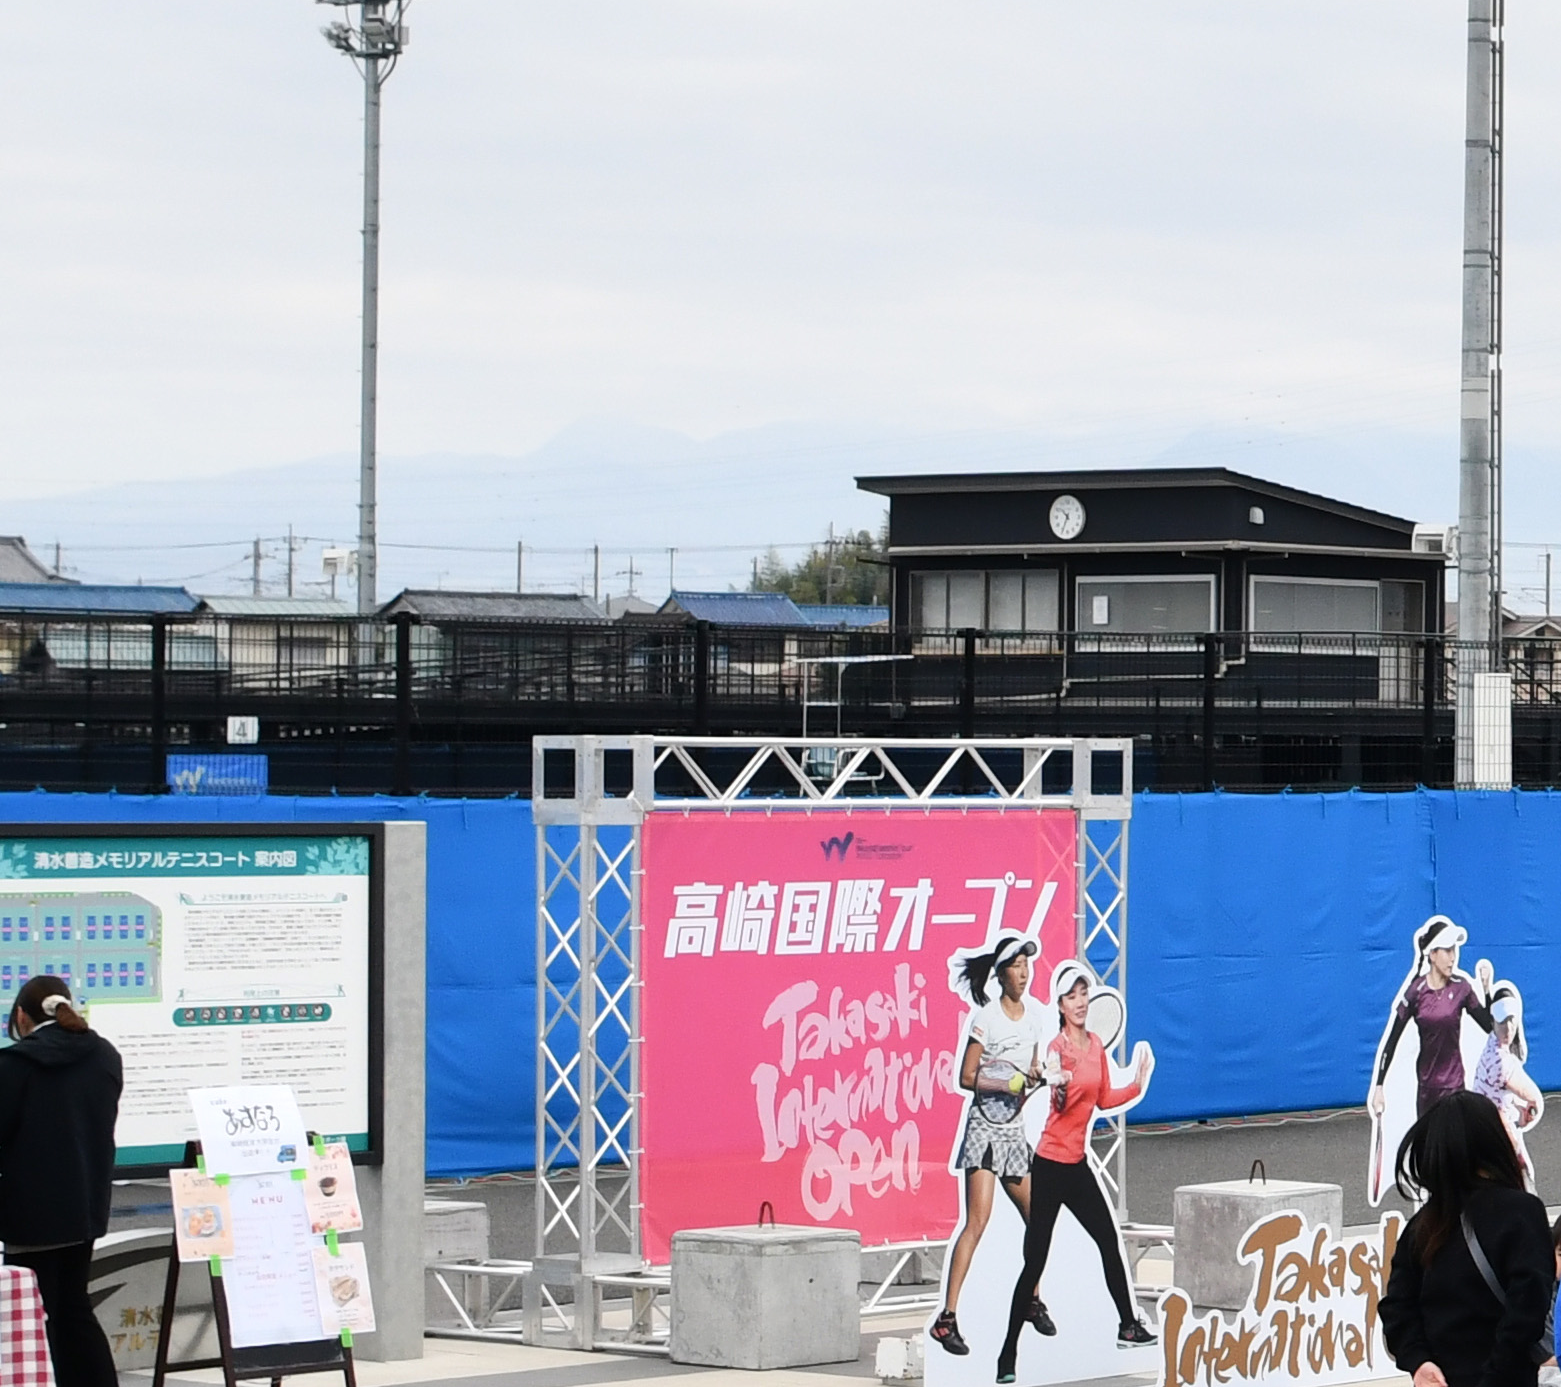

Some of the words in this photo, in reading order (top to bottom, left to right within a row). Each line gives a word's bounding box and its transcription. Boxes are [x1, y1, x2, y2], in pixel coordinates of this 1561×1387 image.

[254, 850, 298, 869] 案内図
[663, 871, 1059, 958] 高崎国際オープン
[762, 962, 928, 1077] Takasaki
[750, 1047, 957, 1163] Internationa
[120, 1304, 164, 1328] 清水
